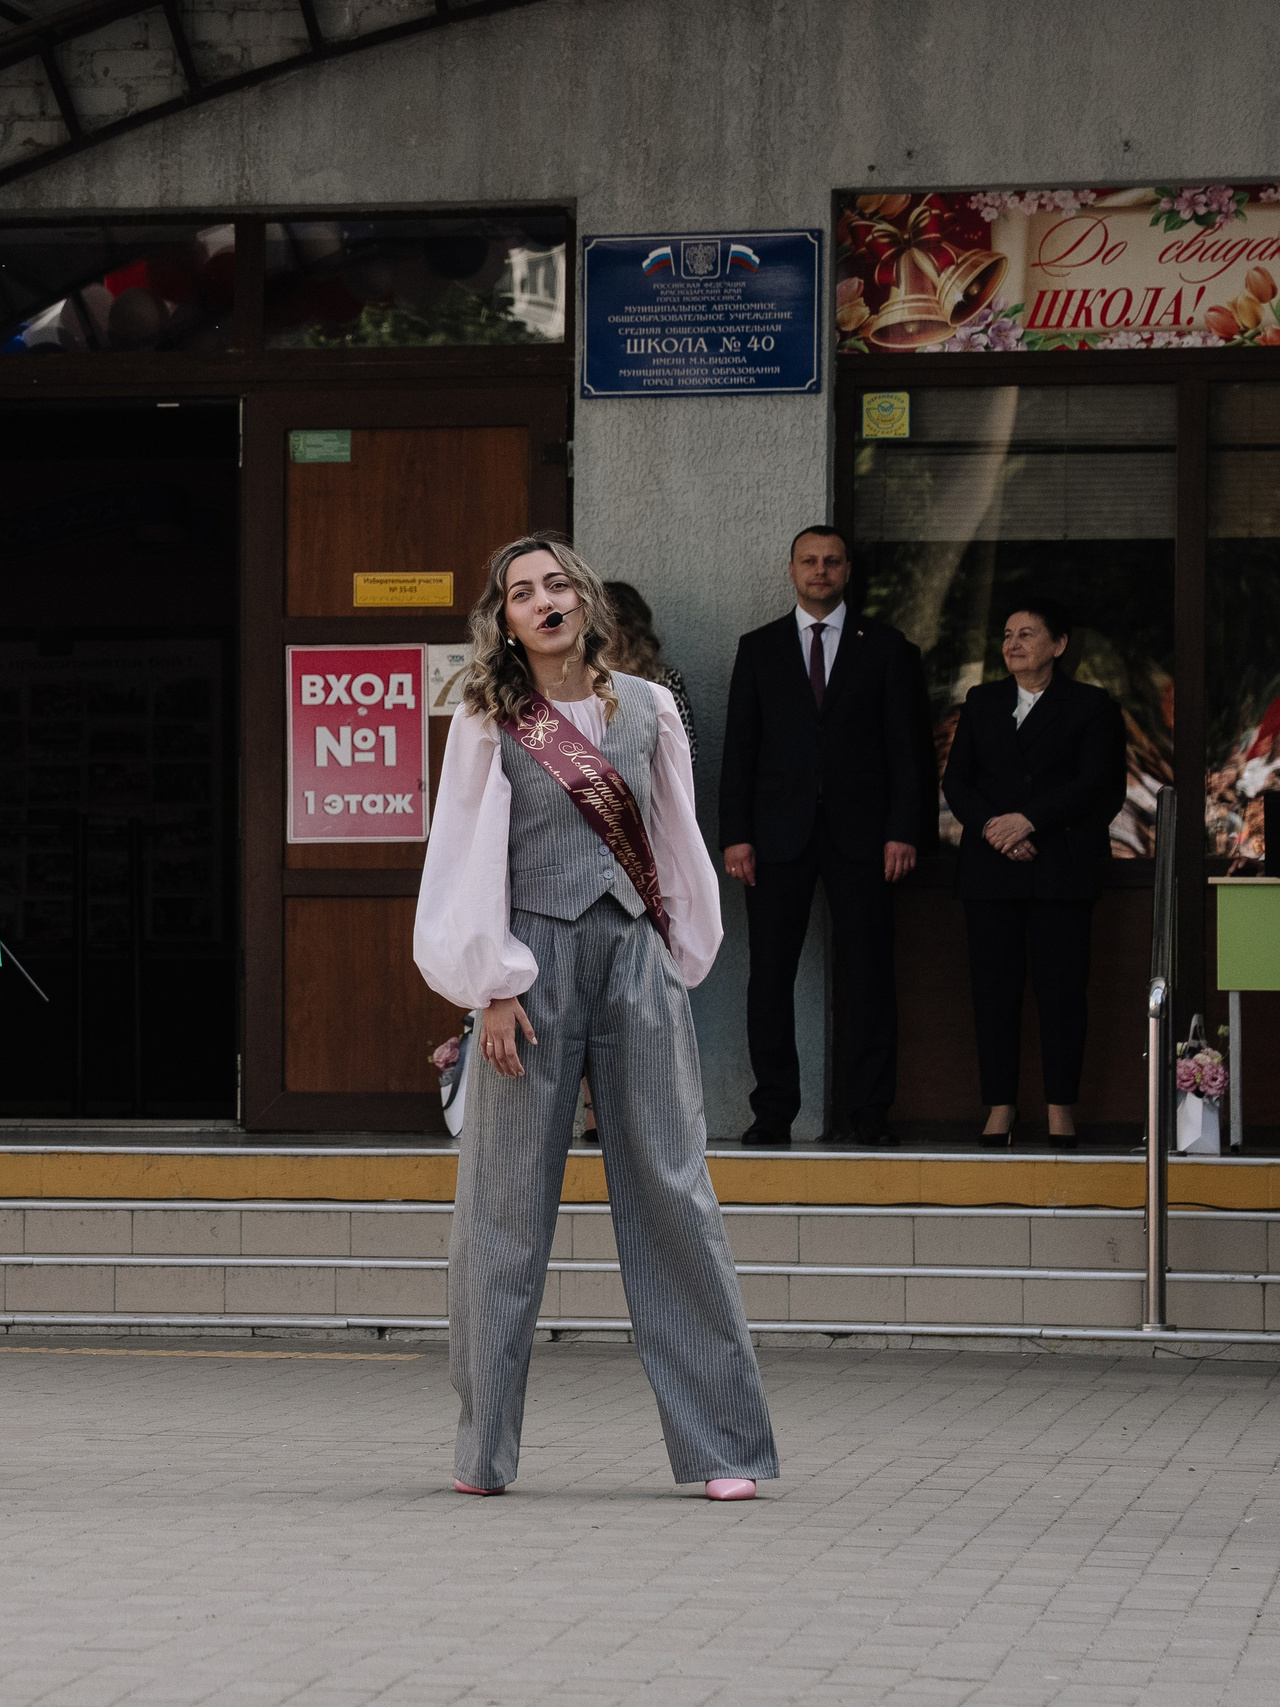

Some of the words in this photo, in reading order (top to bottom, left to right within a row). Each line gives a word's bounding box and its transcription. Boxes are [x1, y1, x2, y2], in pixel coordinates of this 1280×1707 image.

[1031, 213, 1128, 278] До
[653, 281, 701, 289] РОССИЙСКАЯ
[624, 304, 707, 313] МУНИЦИПАЛЬНОЕ
[711, 302, 776, 311] АВТОНОМНОЕ
[1025, 285, 1207, 329] ШКОЛА!
[608, 313, 724, 323] ОБЩЕОБРАЗОВАТЕЛЬНОЕ
[729, 311, 793, 320] УЧРЕЖДЕНИЕ
[619, 327, 661, 335] СРЕДНЯЯ
[666, 325, 781, 334] ОБЩЕОБРАЗОВАТЕЛЬНАЯ
[626, 337, 707, 354] ШКОЛА
[720, 336, 741, 353] №
[747, 336, 775, 352] 40
[652, 357, 685, 365] ИМЕНИ
[619, 368, 708, 377] МУНИЦИПАЛЬНОГО
[713, 366, 780, 375] ОБРАЗОВАНИЯ
[643, 377, 673, 386] ГОРОД
[678, 377, 756, 385] НОВОРОССИЙСК
[300, 673, 416, 710] ВХОД
[315, 725, 397, 767] №1
[558, 740, 623, 814] Классный
[303, 790, 316, 815] 1
[324, 792, 414, 815] этаж
[573, 786, 642, 874] руководитель
